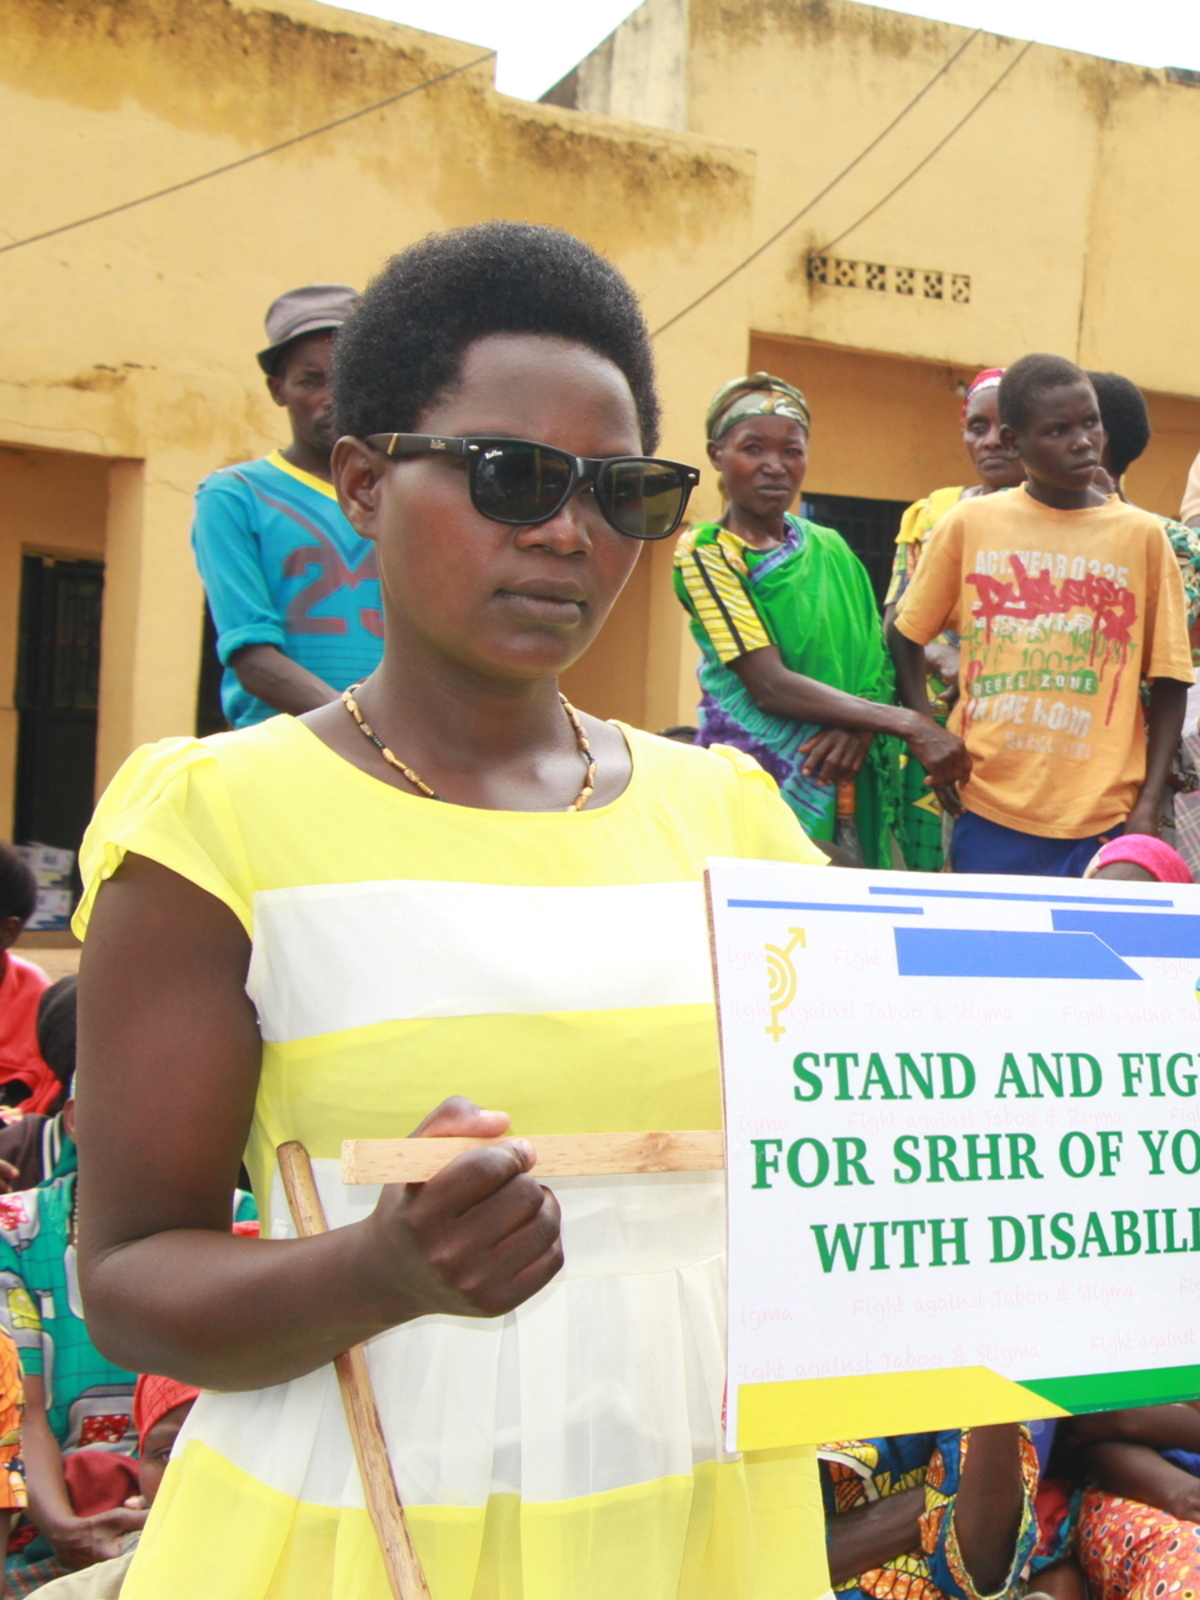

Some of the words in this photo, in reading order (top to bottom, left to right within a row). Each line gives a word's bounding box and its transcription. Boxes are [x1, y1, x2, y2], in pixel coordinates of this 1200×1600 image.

[972, 676, 1026, 696] REBEL
[1039, 675, 1094, 692] ZONE
[832, 948, 882, 974] Fight
[1151, 959, 1193, 980] Fight
[784, 1001, 858, 1025] against
[864, 998, 924, 1020] Taboo
[931, 1000, 947, 1023] &
[953, 1003, 1015, 1027] Stigma
[1061, 1004, 1109, 1029] Fight
[1114, 1005, 1173, 1028] against
[794, 1052, 977, 1102] STAND
[995, 1052, 1103, 1099] AND
[847, 1110, 897, 1136] Fight
[904, 1111, 976, 1136] against
[983, 1108, 1038, 1128] Taboo
[1044, 1106, 1060, 1128] &
[1065, 1110, 1123, 1132] Stigma
[750, 1137, 875, 1190] FOR
[893, 1132, 1044, 1184] SRHR
[1059, 1130, 1124, 1179] OF
[810, 1217, 970, 1273] WITH
[852, 1294, 906, 1322] Fight
[914, 1288, 986, 1319] against
[993, 1284, 1049, 1306] Taboo
[1056, 1283, 1071, 1305] &
[1079, 1282, 1135, 1306] Stigma
[1090, 1333, 1134, 1358] Fight
[1140, 1327, 1196, 1355] against
[737, 1359, 785, 1383] ight
[795, 1353, 873, 1379] against
[881, 1346, 944, 1370] Taboo
[953, 1343, 968, 1366] &
[976, 1342, 1041, 1368] Stigma
